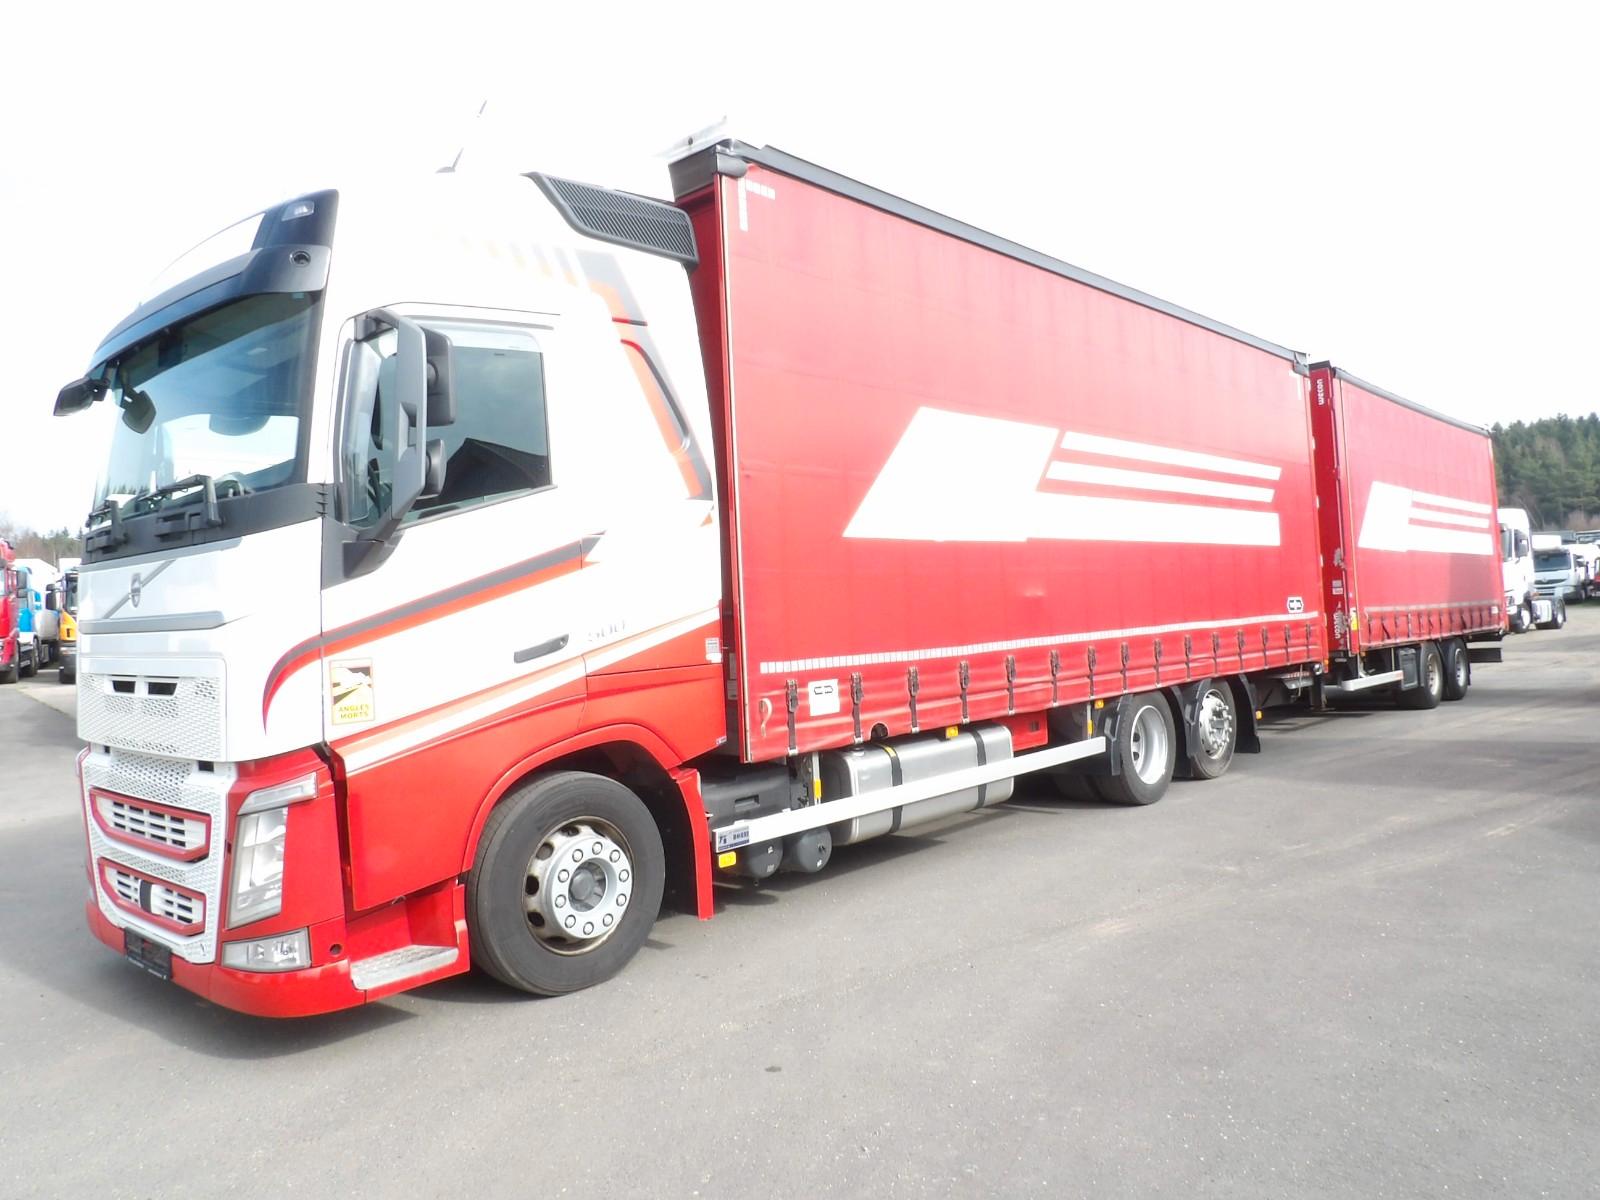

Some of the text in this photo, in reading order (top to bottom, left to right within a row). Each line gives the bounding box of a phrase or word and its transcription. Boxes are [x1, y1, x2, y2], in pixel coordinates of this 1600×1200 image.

[1316, 378, 1325, 406] wecon
[338, 704, 370, 713] ANGLES
[340, 711, 369, 719] MORTS
